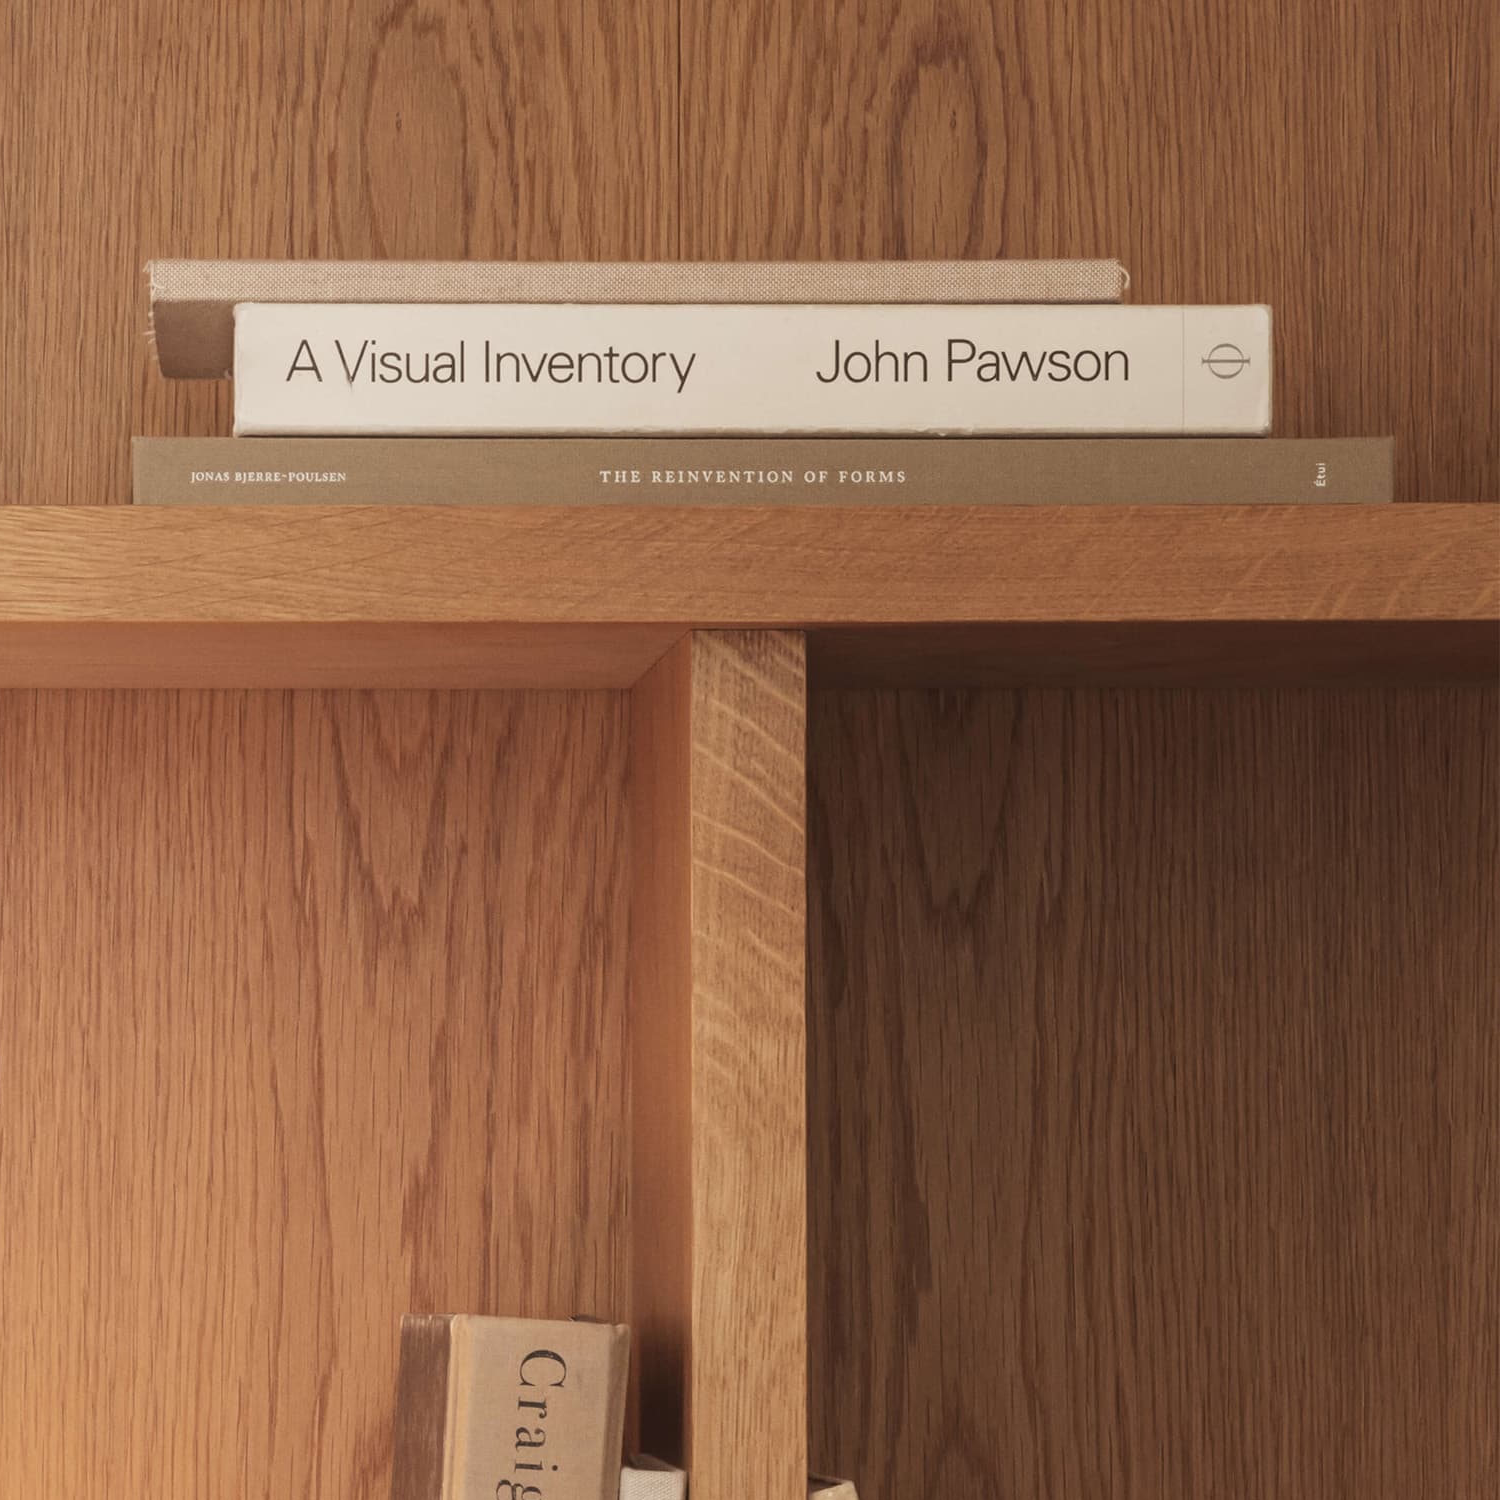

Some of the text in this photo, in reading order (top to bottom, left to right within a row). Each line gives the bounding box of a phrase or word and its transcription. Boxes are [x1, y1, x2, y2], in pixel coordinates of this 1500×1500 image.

[285, 339, 697, 393] A Visual Inventory
[815, 339, 1130, 384] John Pawson
[190, 471, 347, 483] JONAS BJERRE-POULSEN
[599, 470, 907, 483] THE REINVENTION OF FORMS
[1313, 462, 1326, 487] Étui
